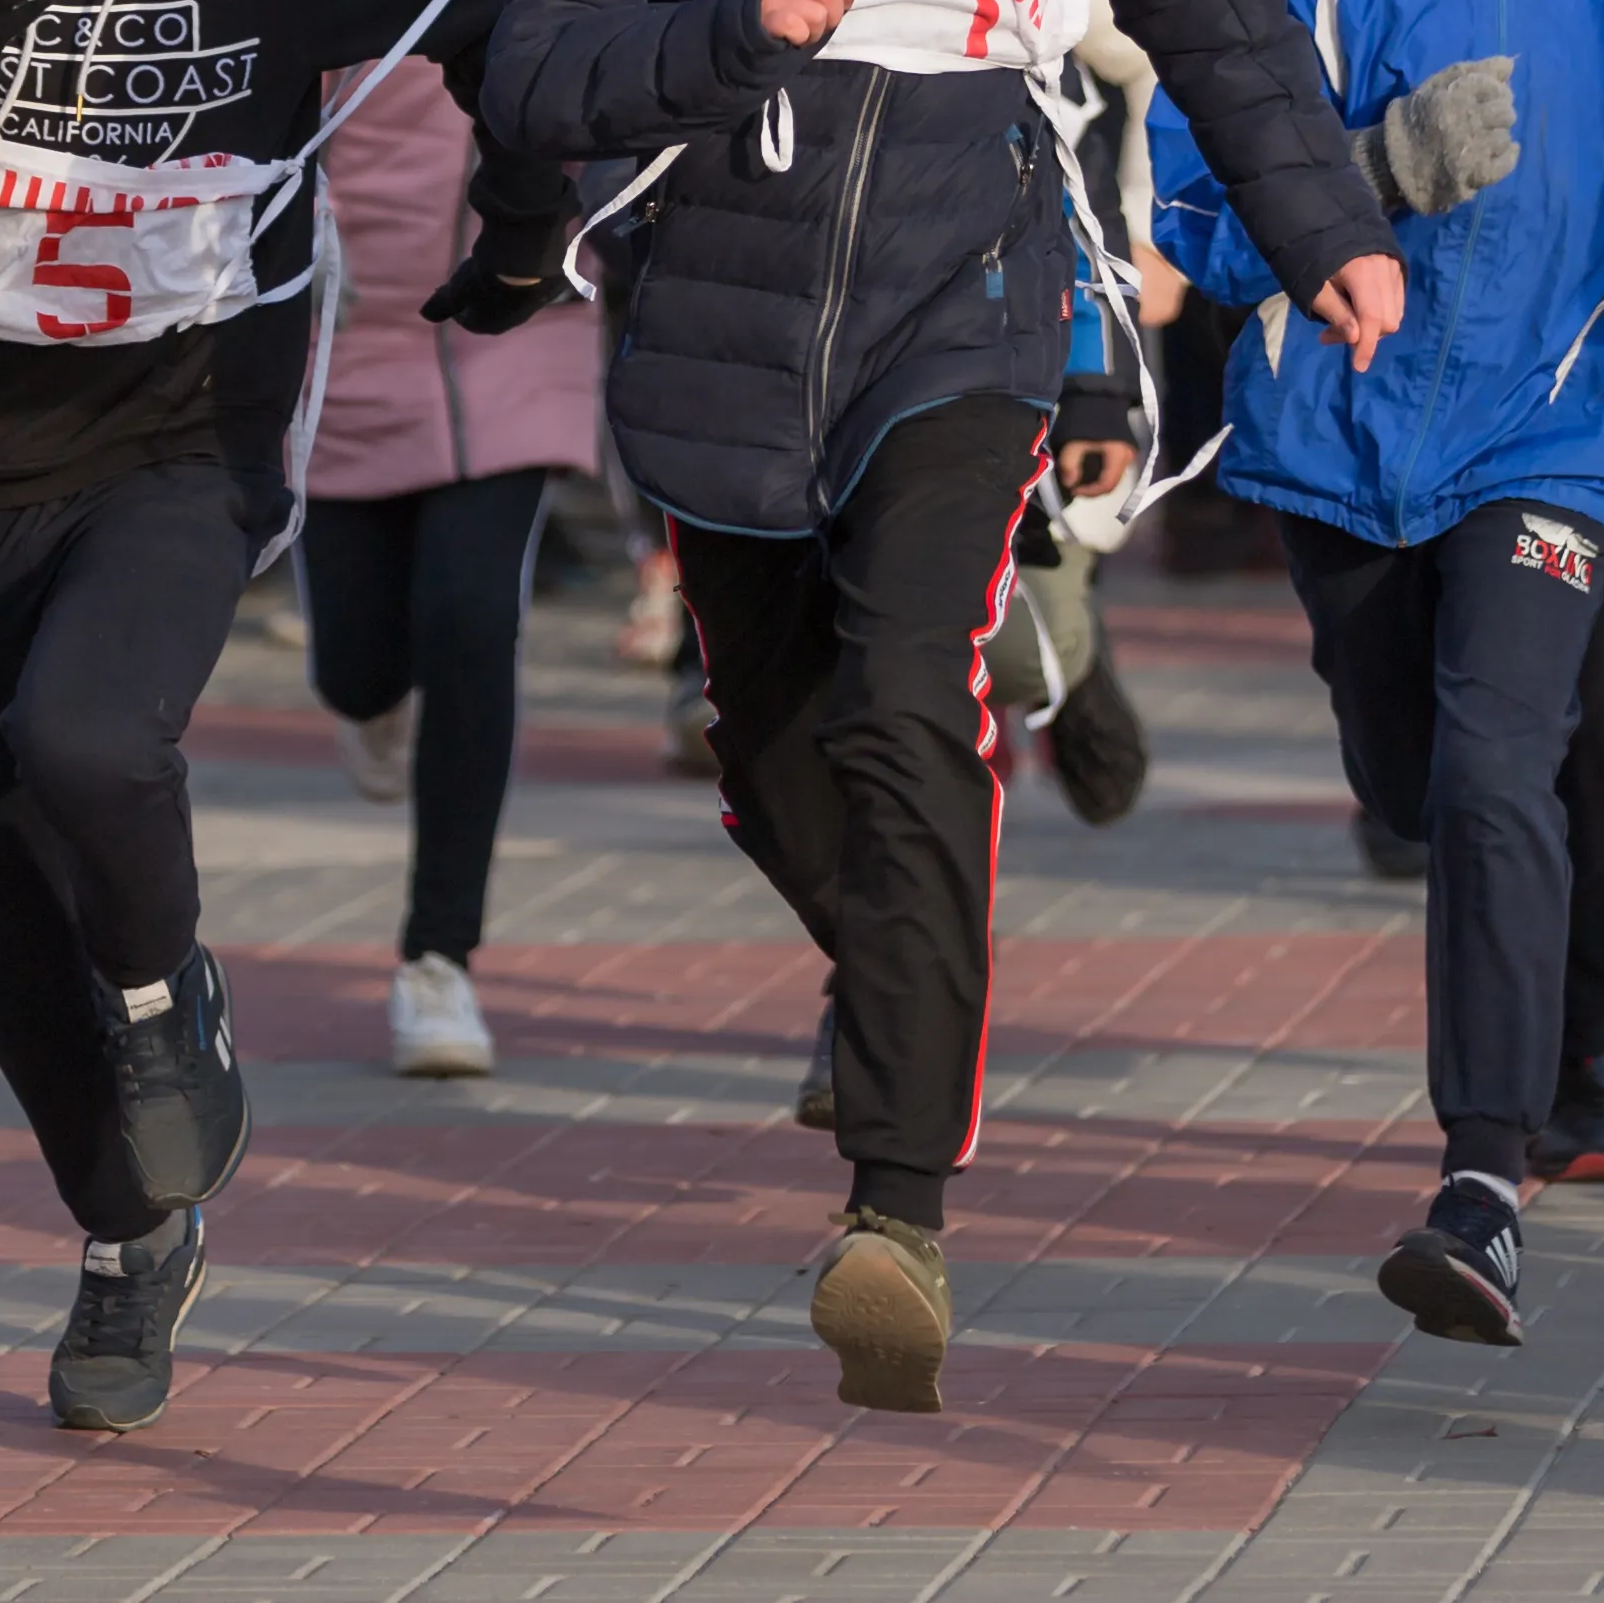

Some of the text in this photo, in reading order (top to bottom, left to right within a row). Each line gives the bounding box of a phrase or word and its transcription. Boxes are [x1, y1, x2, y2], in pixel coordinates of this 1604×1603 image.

[74, 17, 103, 48] &
[114, 12, 187, 47] CO
[82, 52, 258, 105] COAST
[0, 112, 173, 145] CALIFORNIA
[32, 208, 134, 340] 5
[1511, 554, 1543, 570] SPORT
[1514, 535, 1593, 586] BOXING
